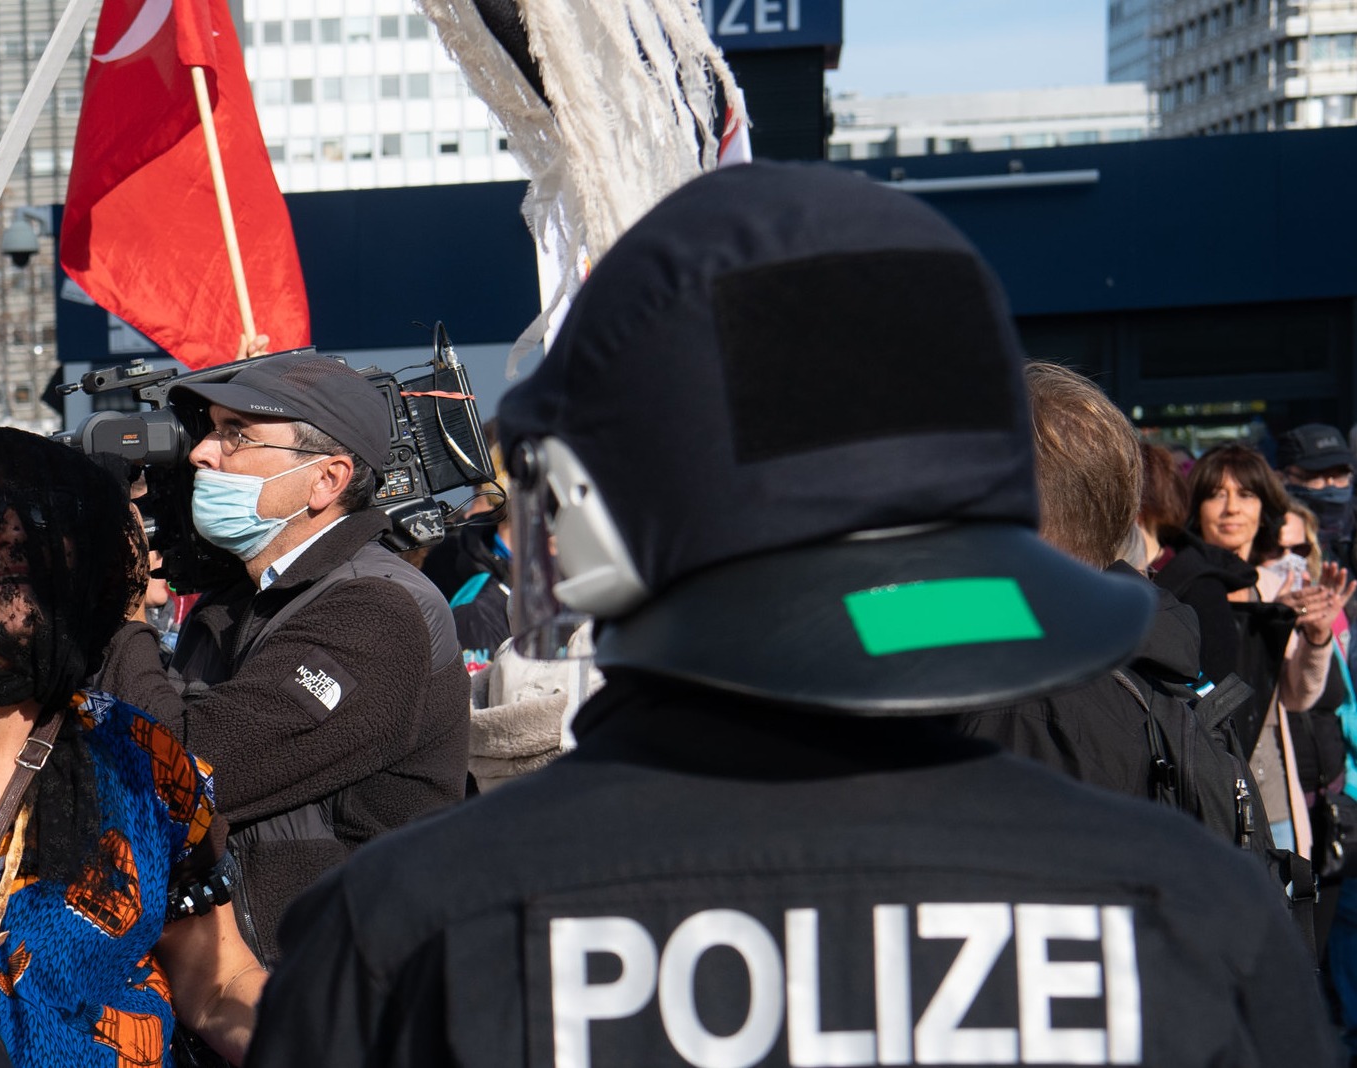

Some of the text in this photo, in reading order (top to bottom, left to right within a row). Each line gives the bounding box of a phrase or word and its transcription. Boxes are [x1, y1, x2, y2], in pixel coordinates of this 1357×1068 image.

[296, 665, 331, 693] NORTH
[298, 678, 324, 699] FACE
[316, 669, 336, 687] THE
[550, 902, 1141, 1068] POLIZEI
